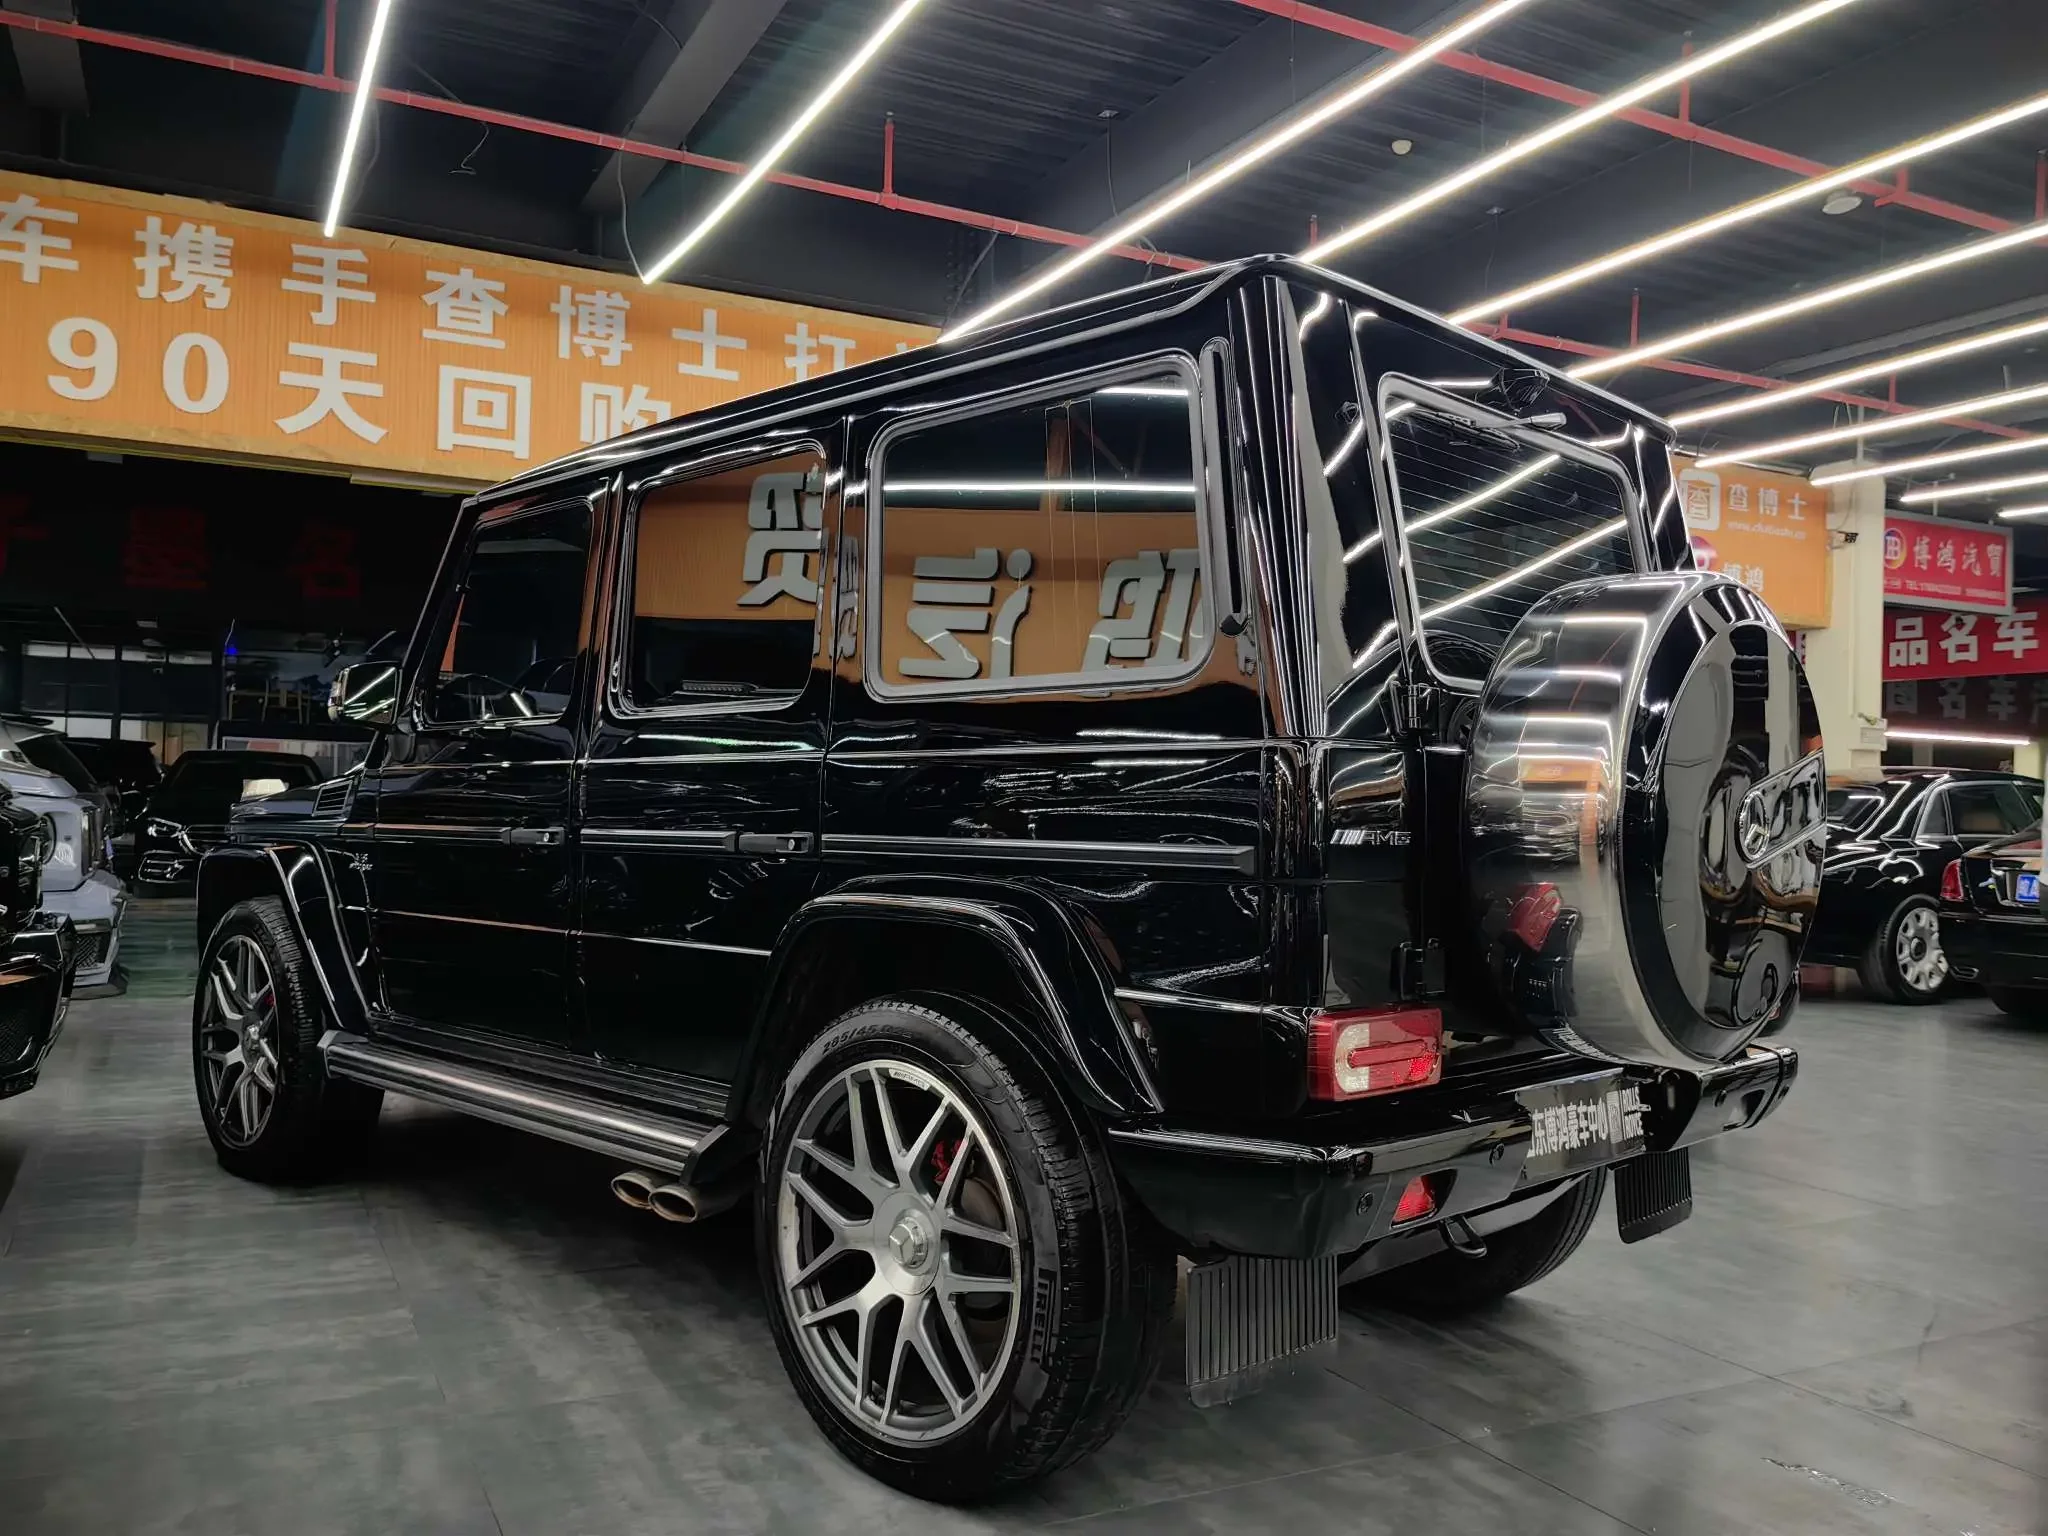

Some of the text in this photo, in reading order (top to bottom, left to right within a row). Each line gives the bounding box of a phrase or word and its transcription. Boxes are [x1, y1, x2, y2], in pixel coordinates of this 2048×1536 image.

[0, 194, 908, 383] 车携手查博士打
[1727, 483, 1808, 521] 查博士
[1888, 607, 2040, 668] 品名车
[1358, 830, 1412, 846] AMG
